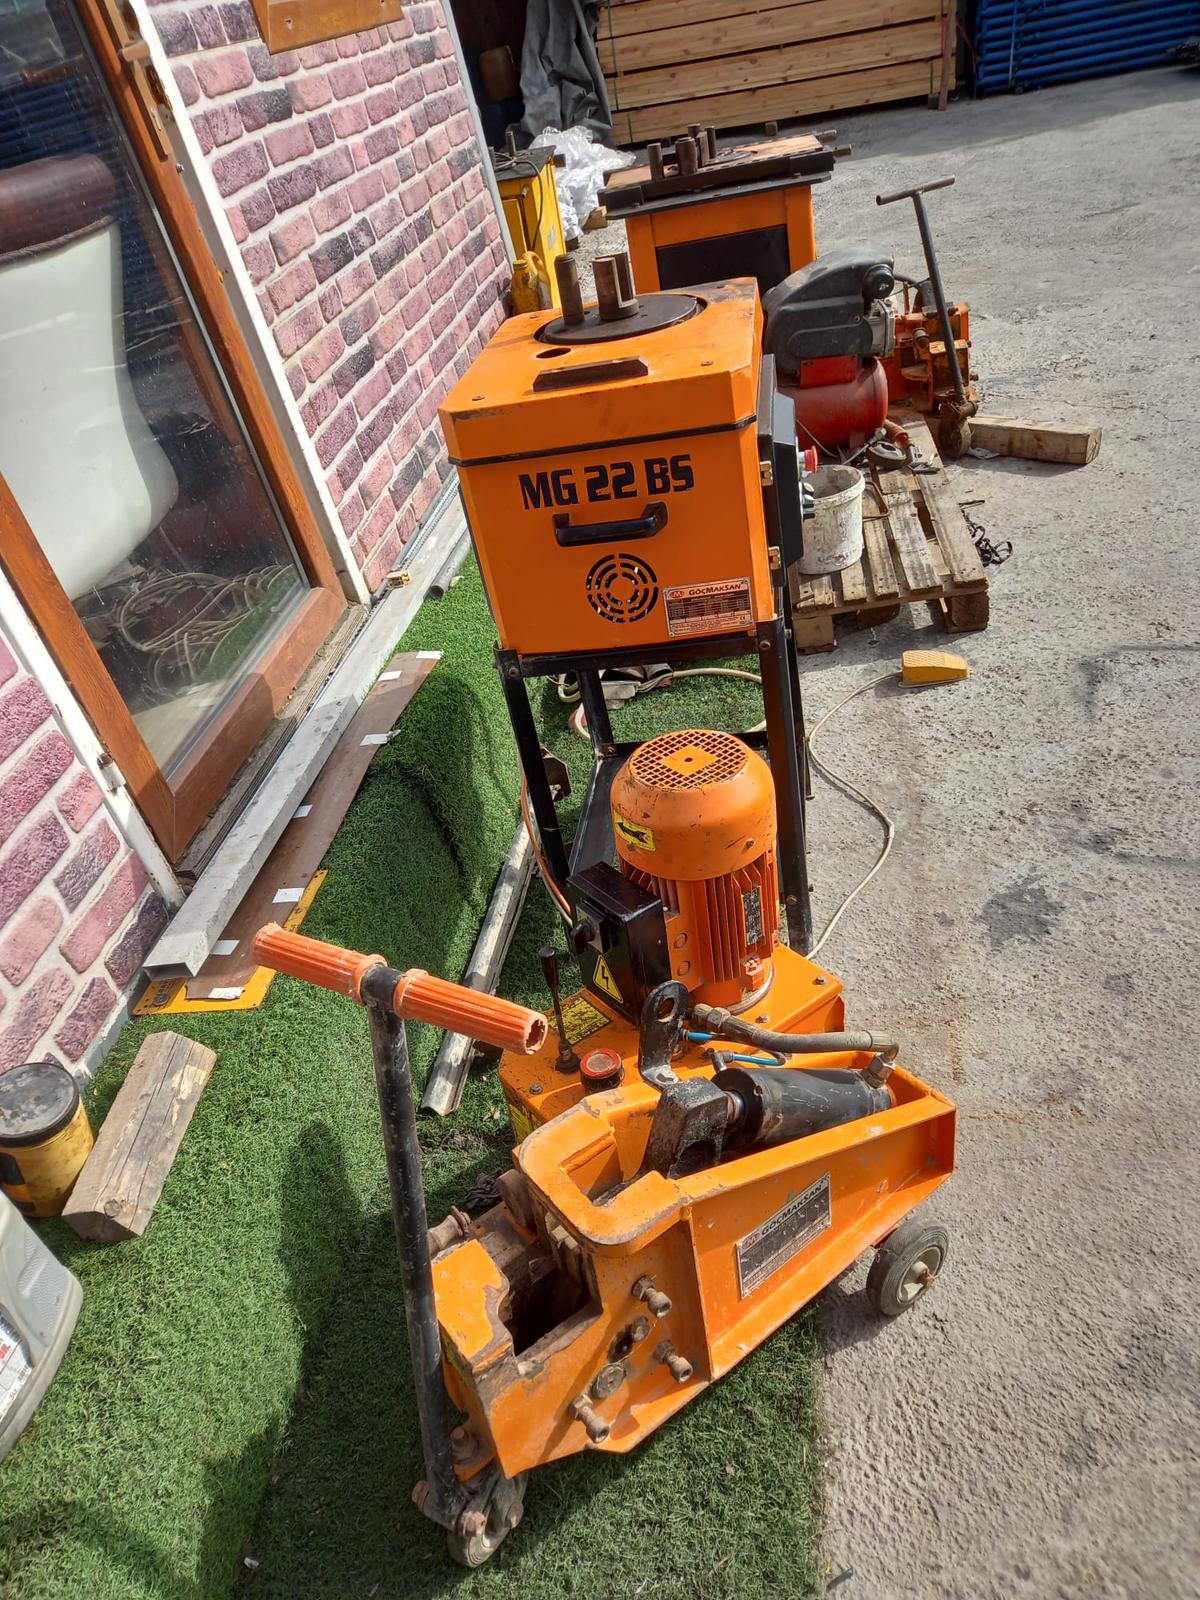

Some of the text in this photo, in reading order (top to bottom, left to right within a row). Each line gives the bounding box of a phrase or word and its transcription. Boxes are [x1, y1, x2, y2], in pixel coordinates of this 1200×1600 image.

[518, 454, 694, 510] MG 22 BS
